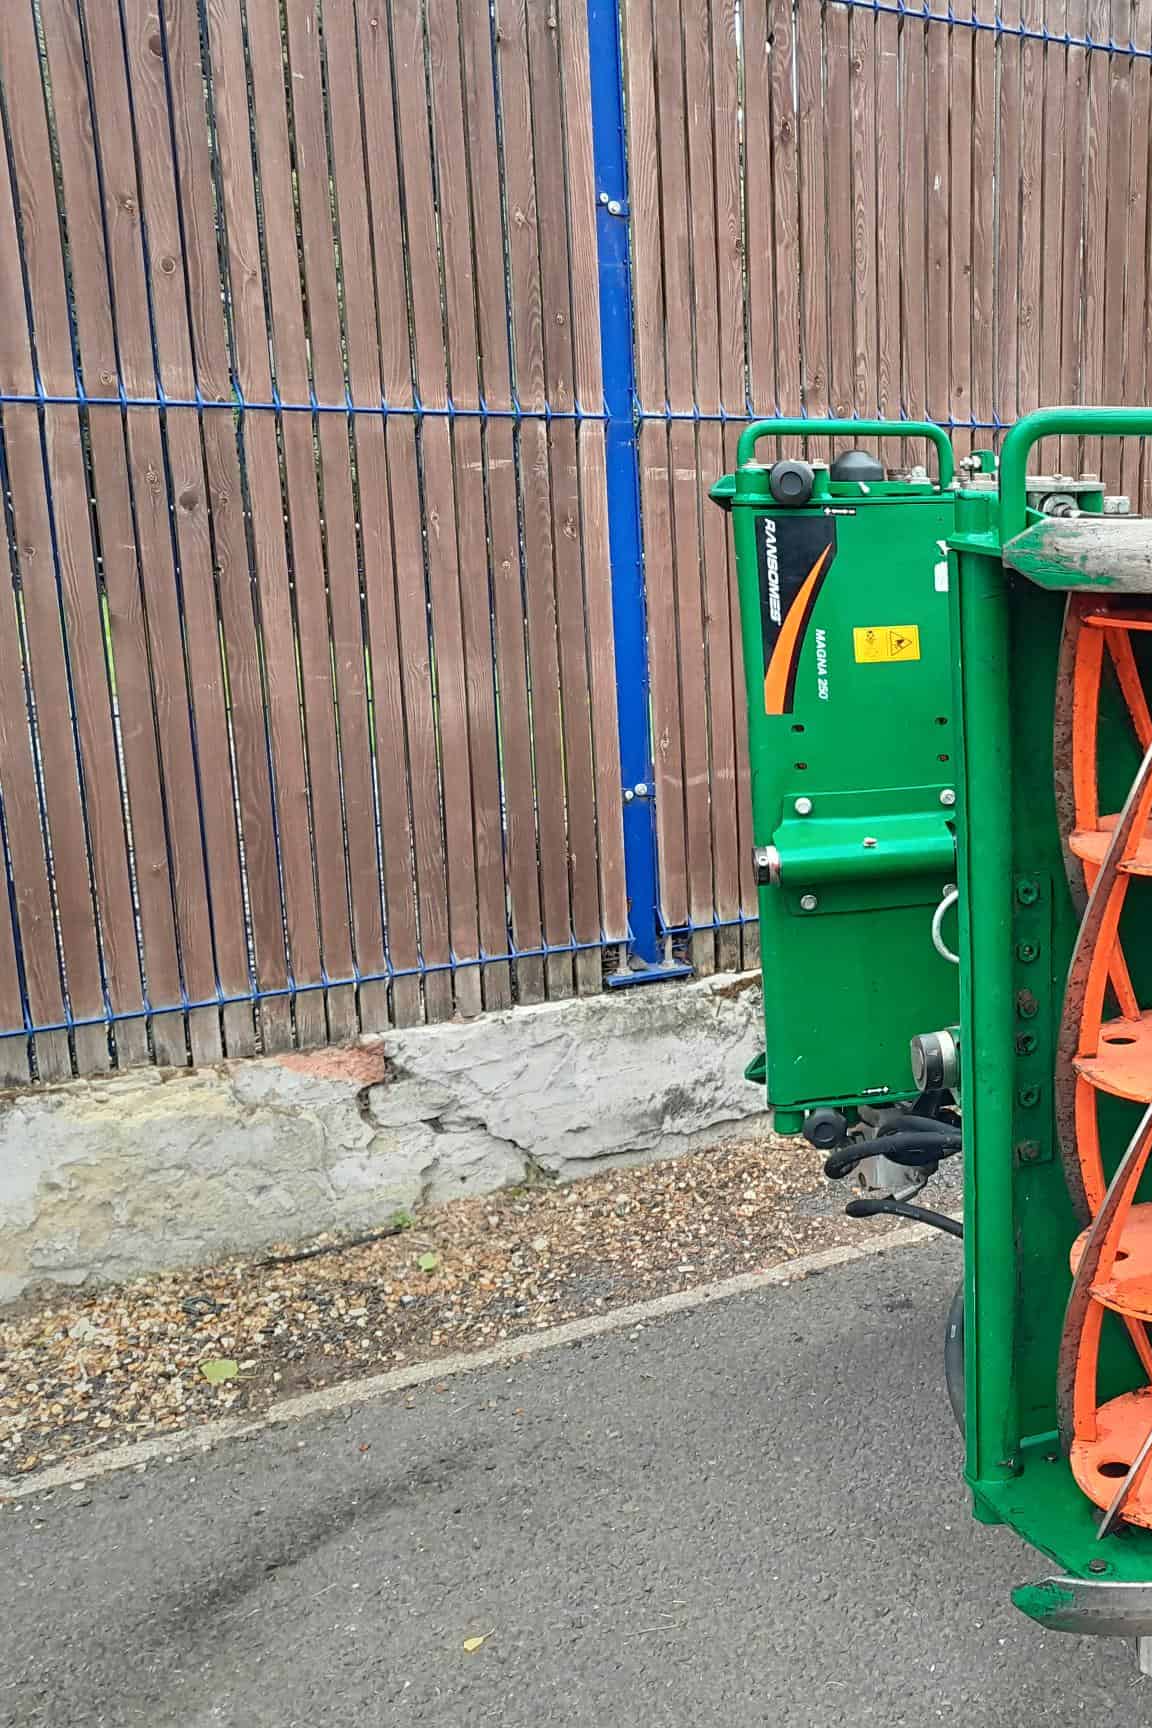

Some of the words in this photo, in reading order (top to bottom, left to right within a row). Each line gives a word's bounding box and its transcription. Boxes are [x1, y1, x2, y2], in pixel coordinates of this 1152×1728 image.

[764, 518, 782, 626] RANSOMES
[815, 628, 828, 675] MAGNA
[817, 678, 829, 700] 250
